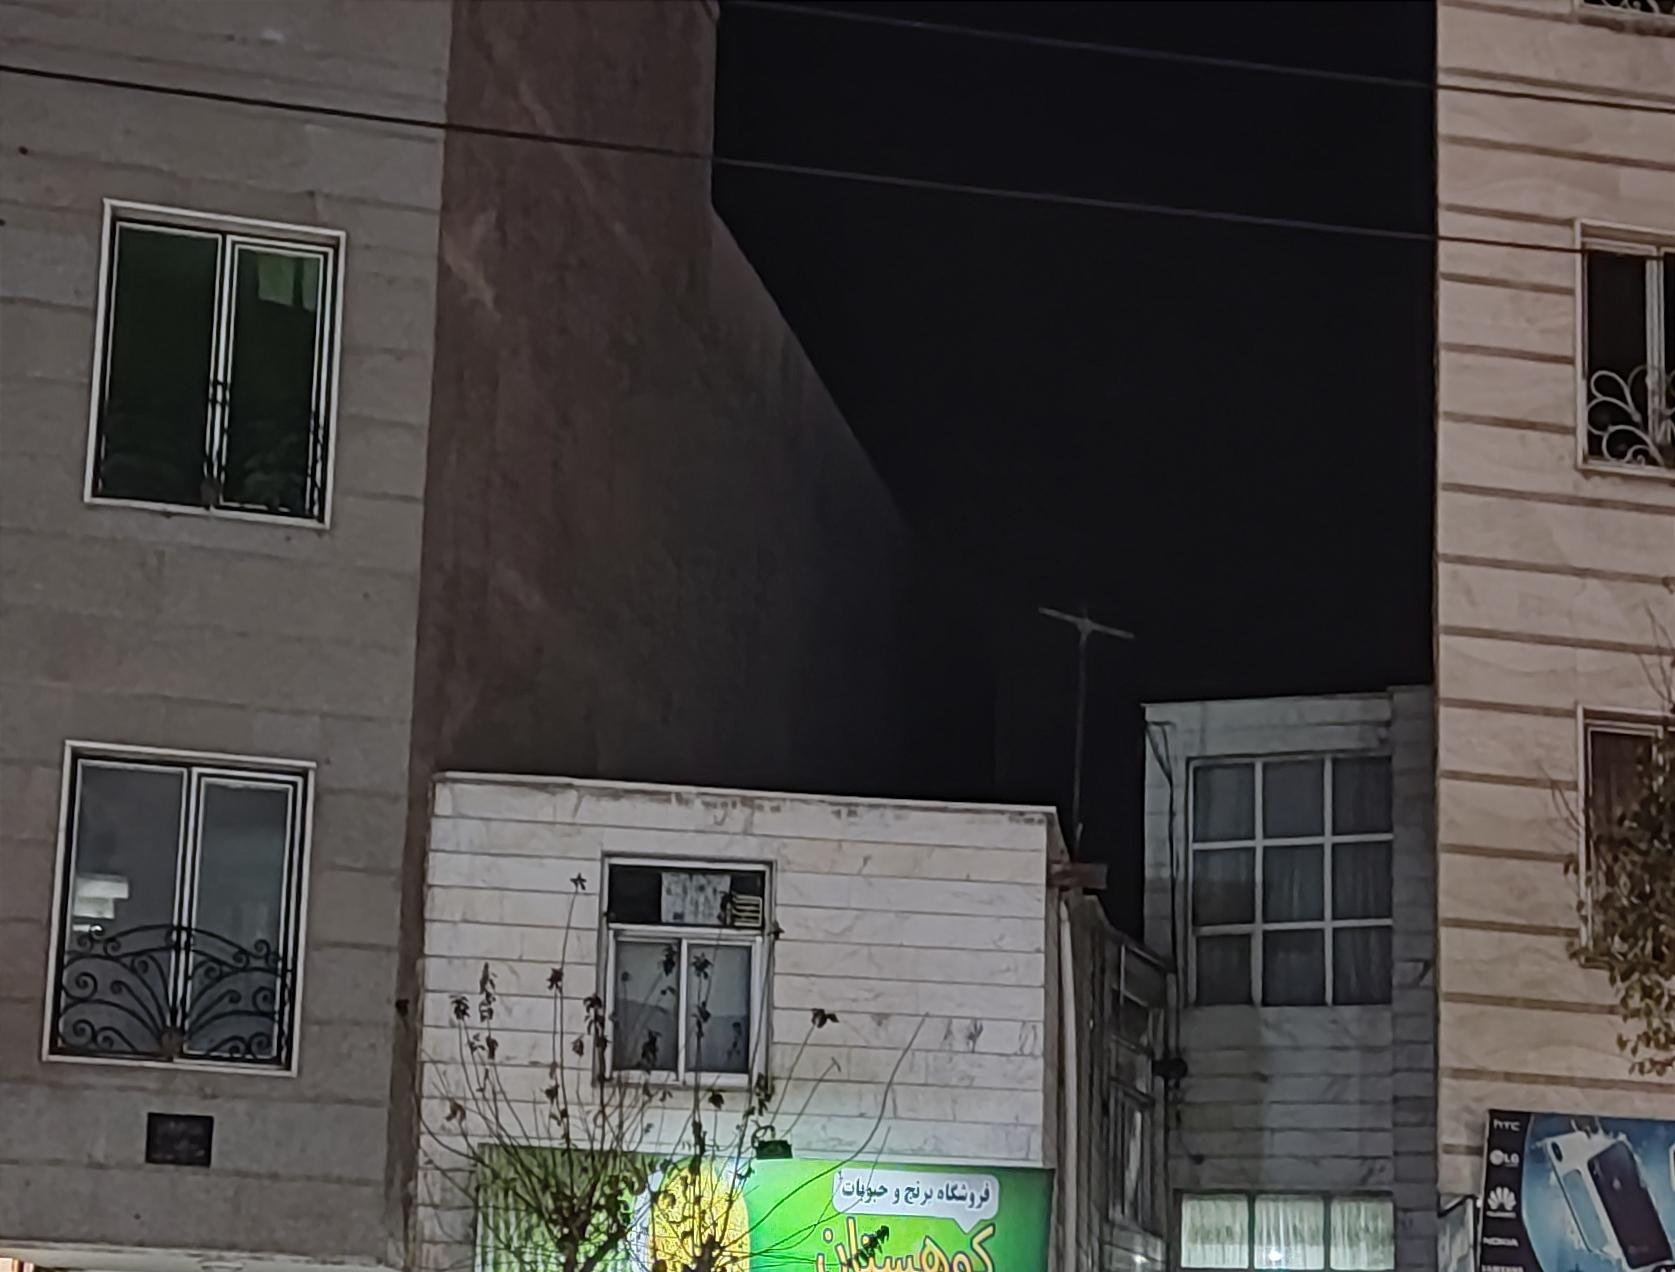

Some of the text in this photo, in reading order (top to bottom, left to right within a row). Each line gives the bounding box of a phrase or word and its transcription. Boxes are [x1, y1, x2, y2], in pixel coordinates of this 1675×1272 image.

[1503, 1152, 1520, 1165] LG
[842, 1178, 990, 1209] فروشگاه برنج و حبوبات
